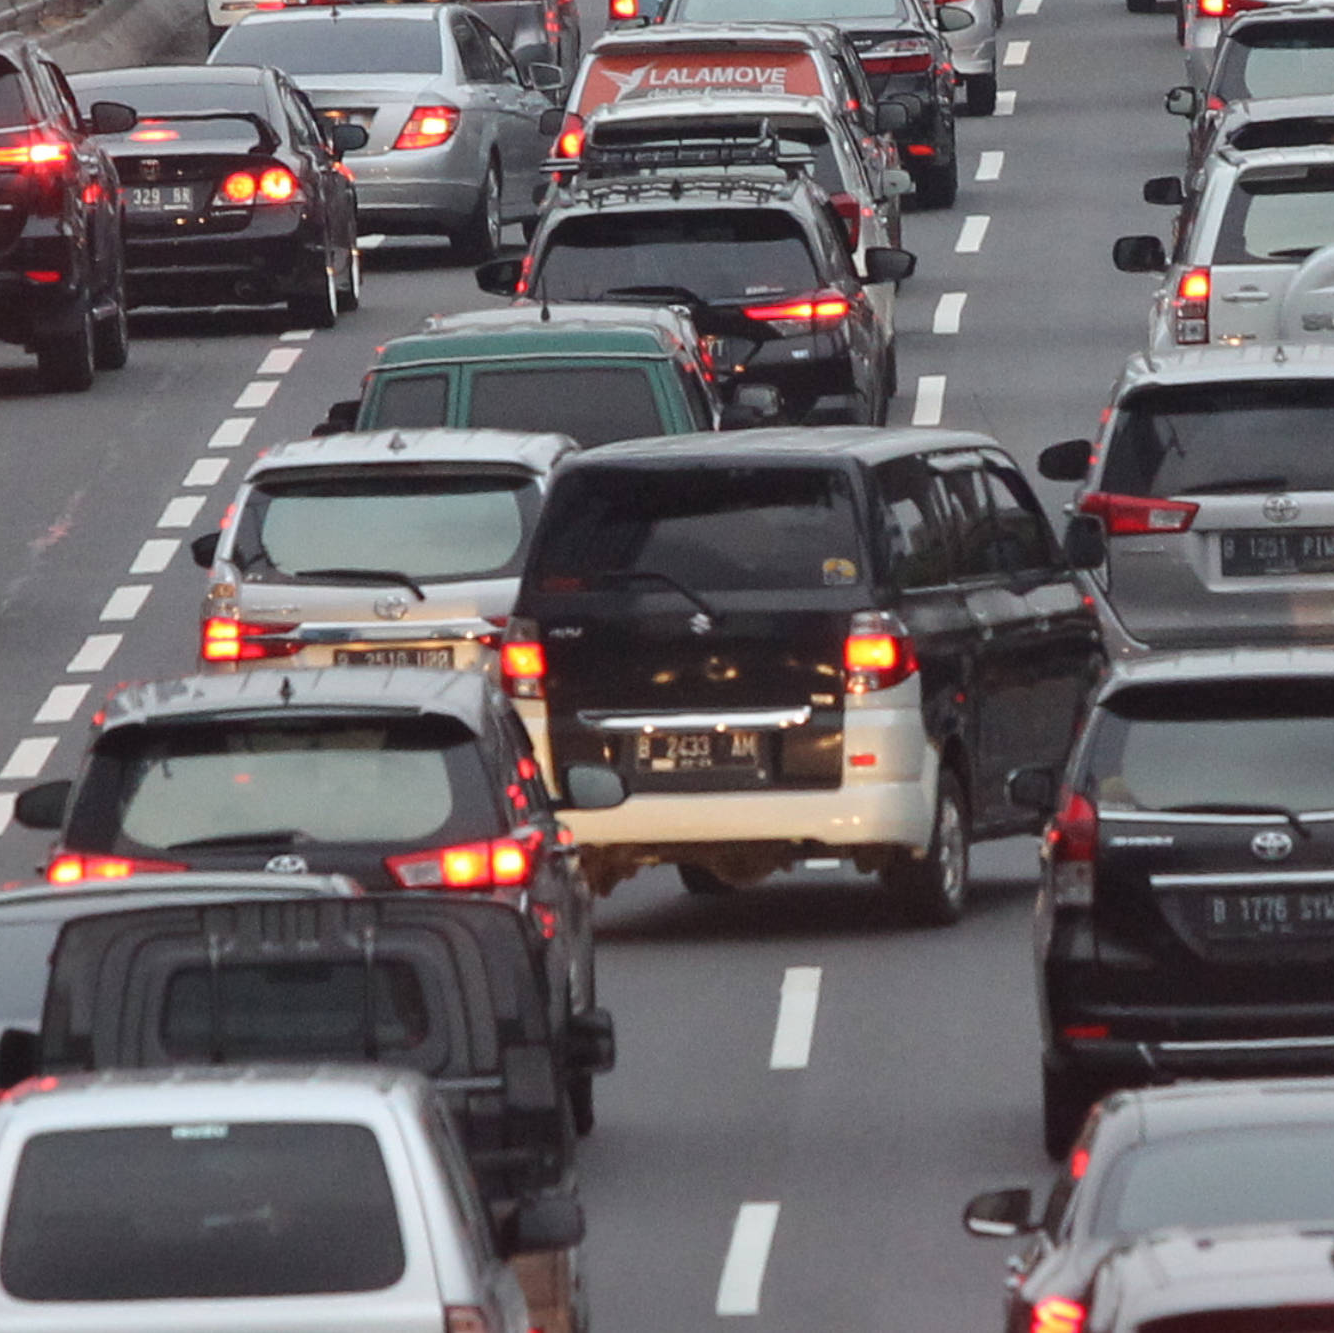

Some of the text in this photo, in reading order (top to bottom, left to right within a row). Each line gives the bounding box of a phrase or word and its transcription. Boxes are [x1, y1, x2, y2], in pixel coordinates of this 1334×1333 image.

[649, 67, 787, 85] LALAMOVE
[133, 187, 161, 205] 329
[637, 737, 651, 760] B
[666, 735, 711, 758] 2433
